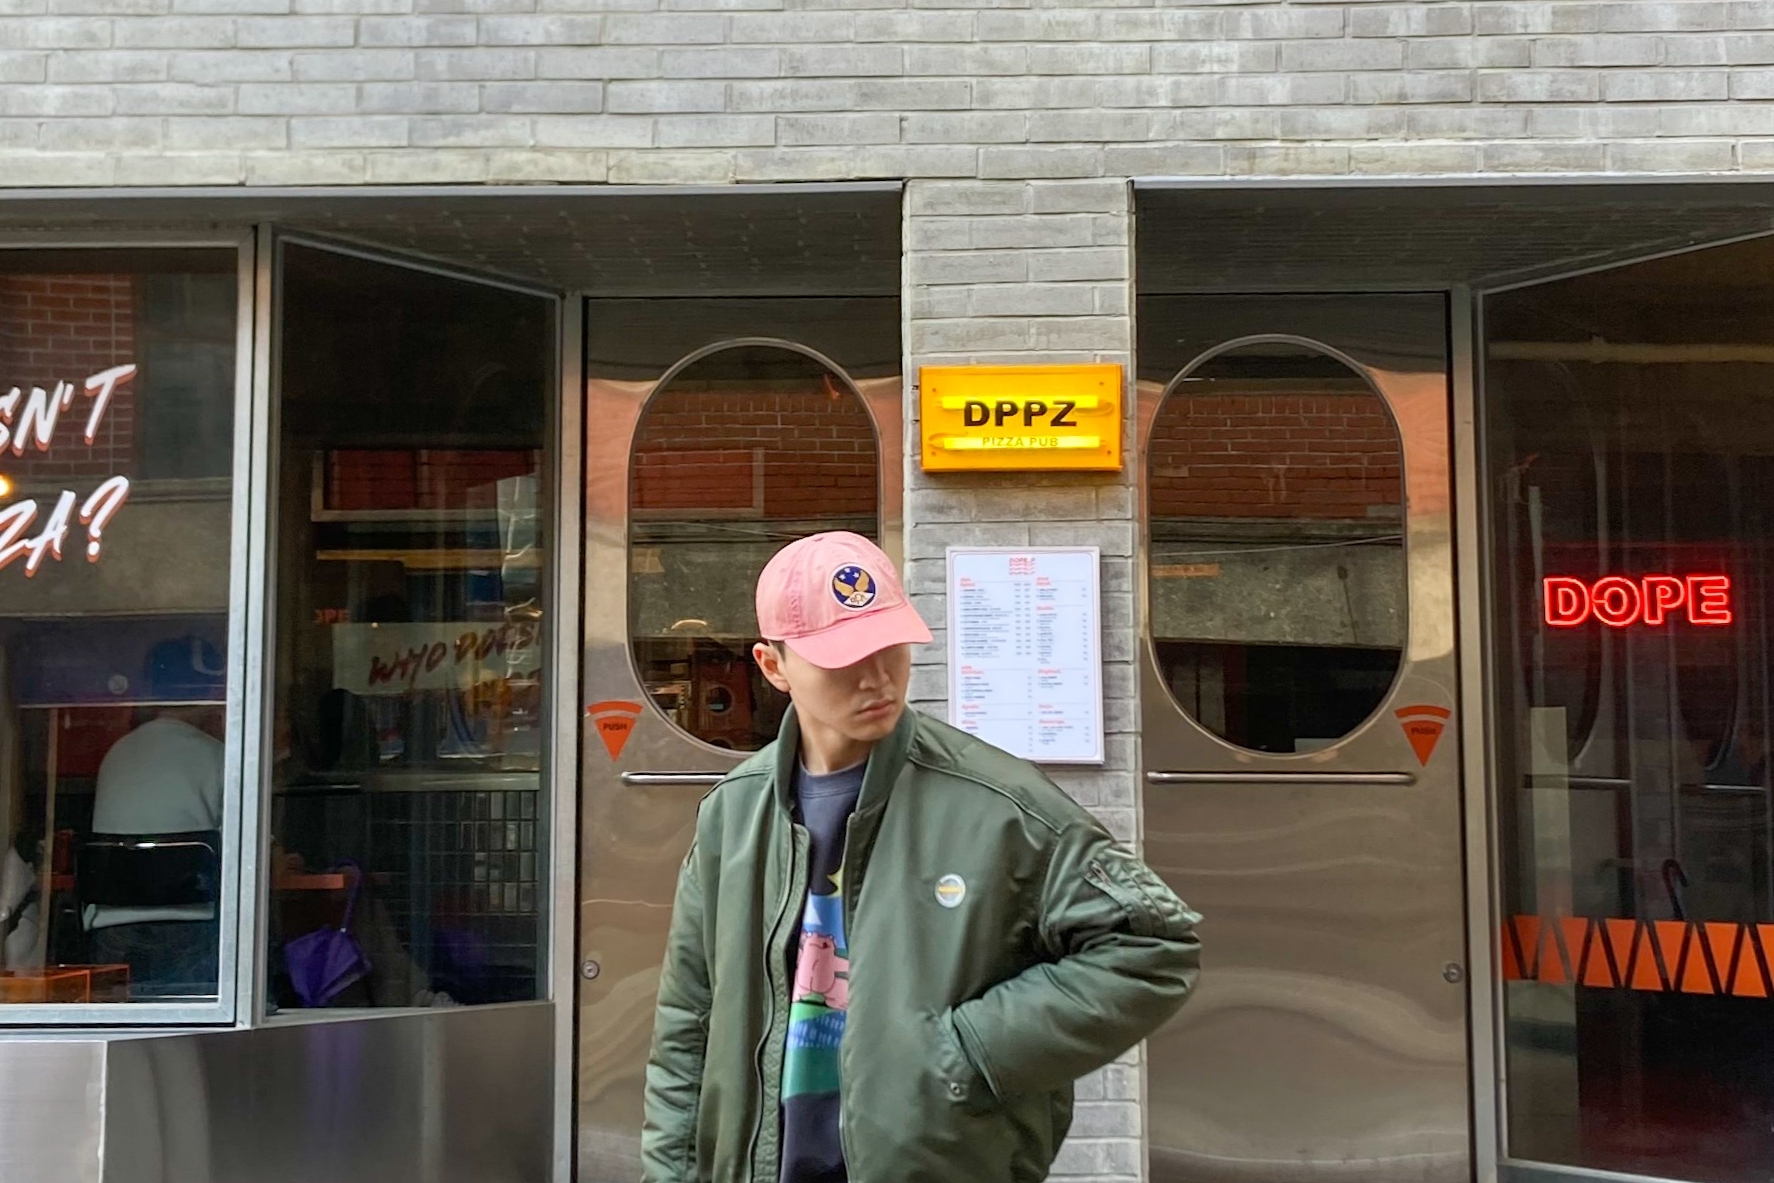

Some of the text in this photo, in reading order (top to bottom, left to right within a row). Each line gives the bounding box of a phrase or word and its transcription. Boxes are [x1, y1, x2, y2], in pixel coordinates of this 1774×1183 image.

[963, 399, 1077, 427] DPPZ
[982, 436, 1059, 447] PIZZA PUB
[1543, 575, 1732, 627] DOPE
[602, 723, 627, 731] PUSH
